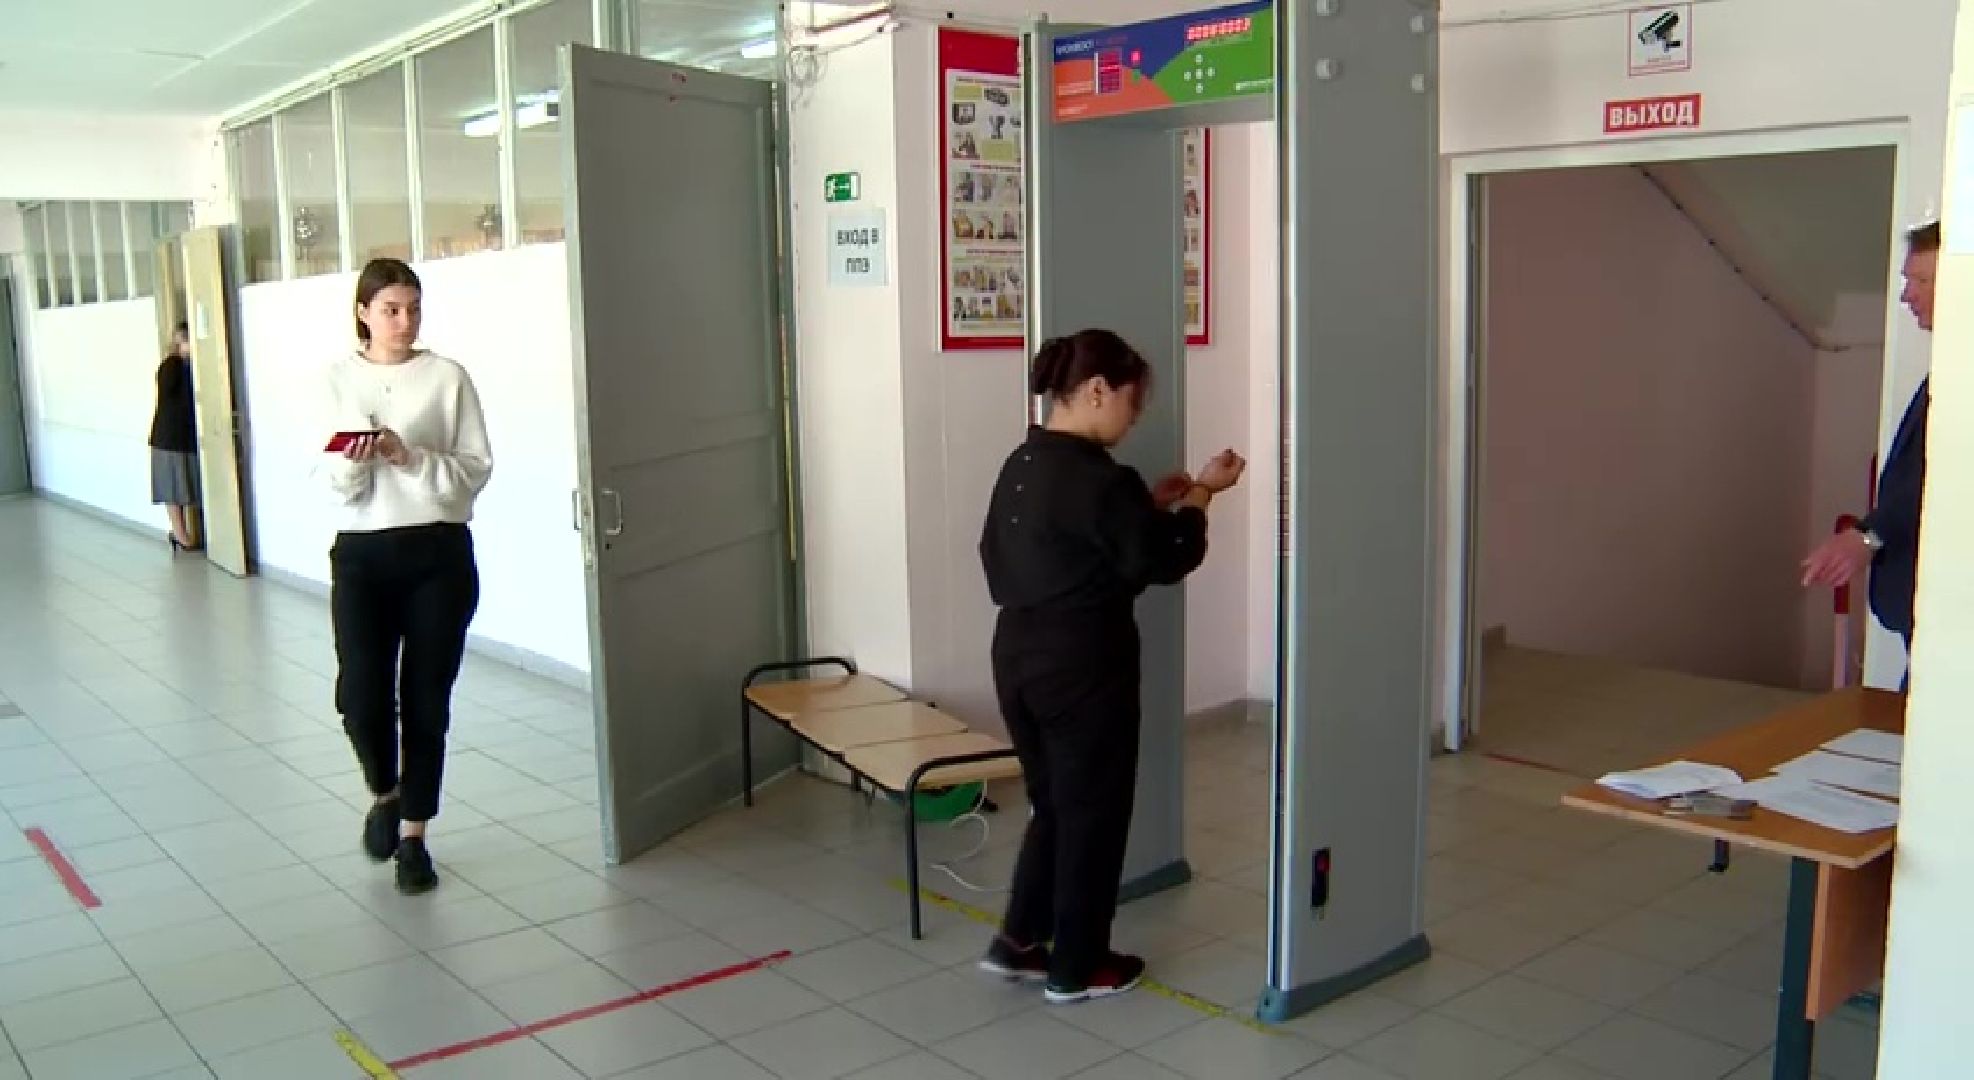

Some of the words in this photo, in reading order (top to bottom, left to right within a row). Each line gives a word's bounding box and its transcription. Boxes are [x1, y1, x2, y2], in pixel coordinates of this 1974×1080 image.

[1609, 101, 1694, 128] ВЫХОД
[837, 229, 868, 248] ВХОД
[871, 228, 879, 245] В
[846, 257, 870, 273] ППЭ
